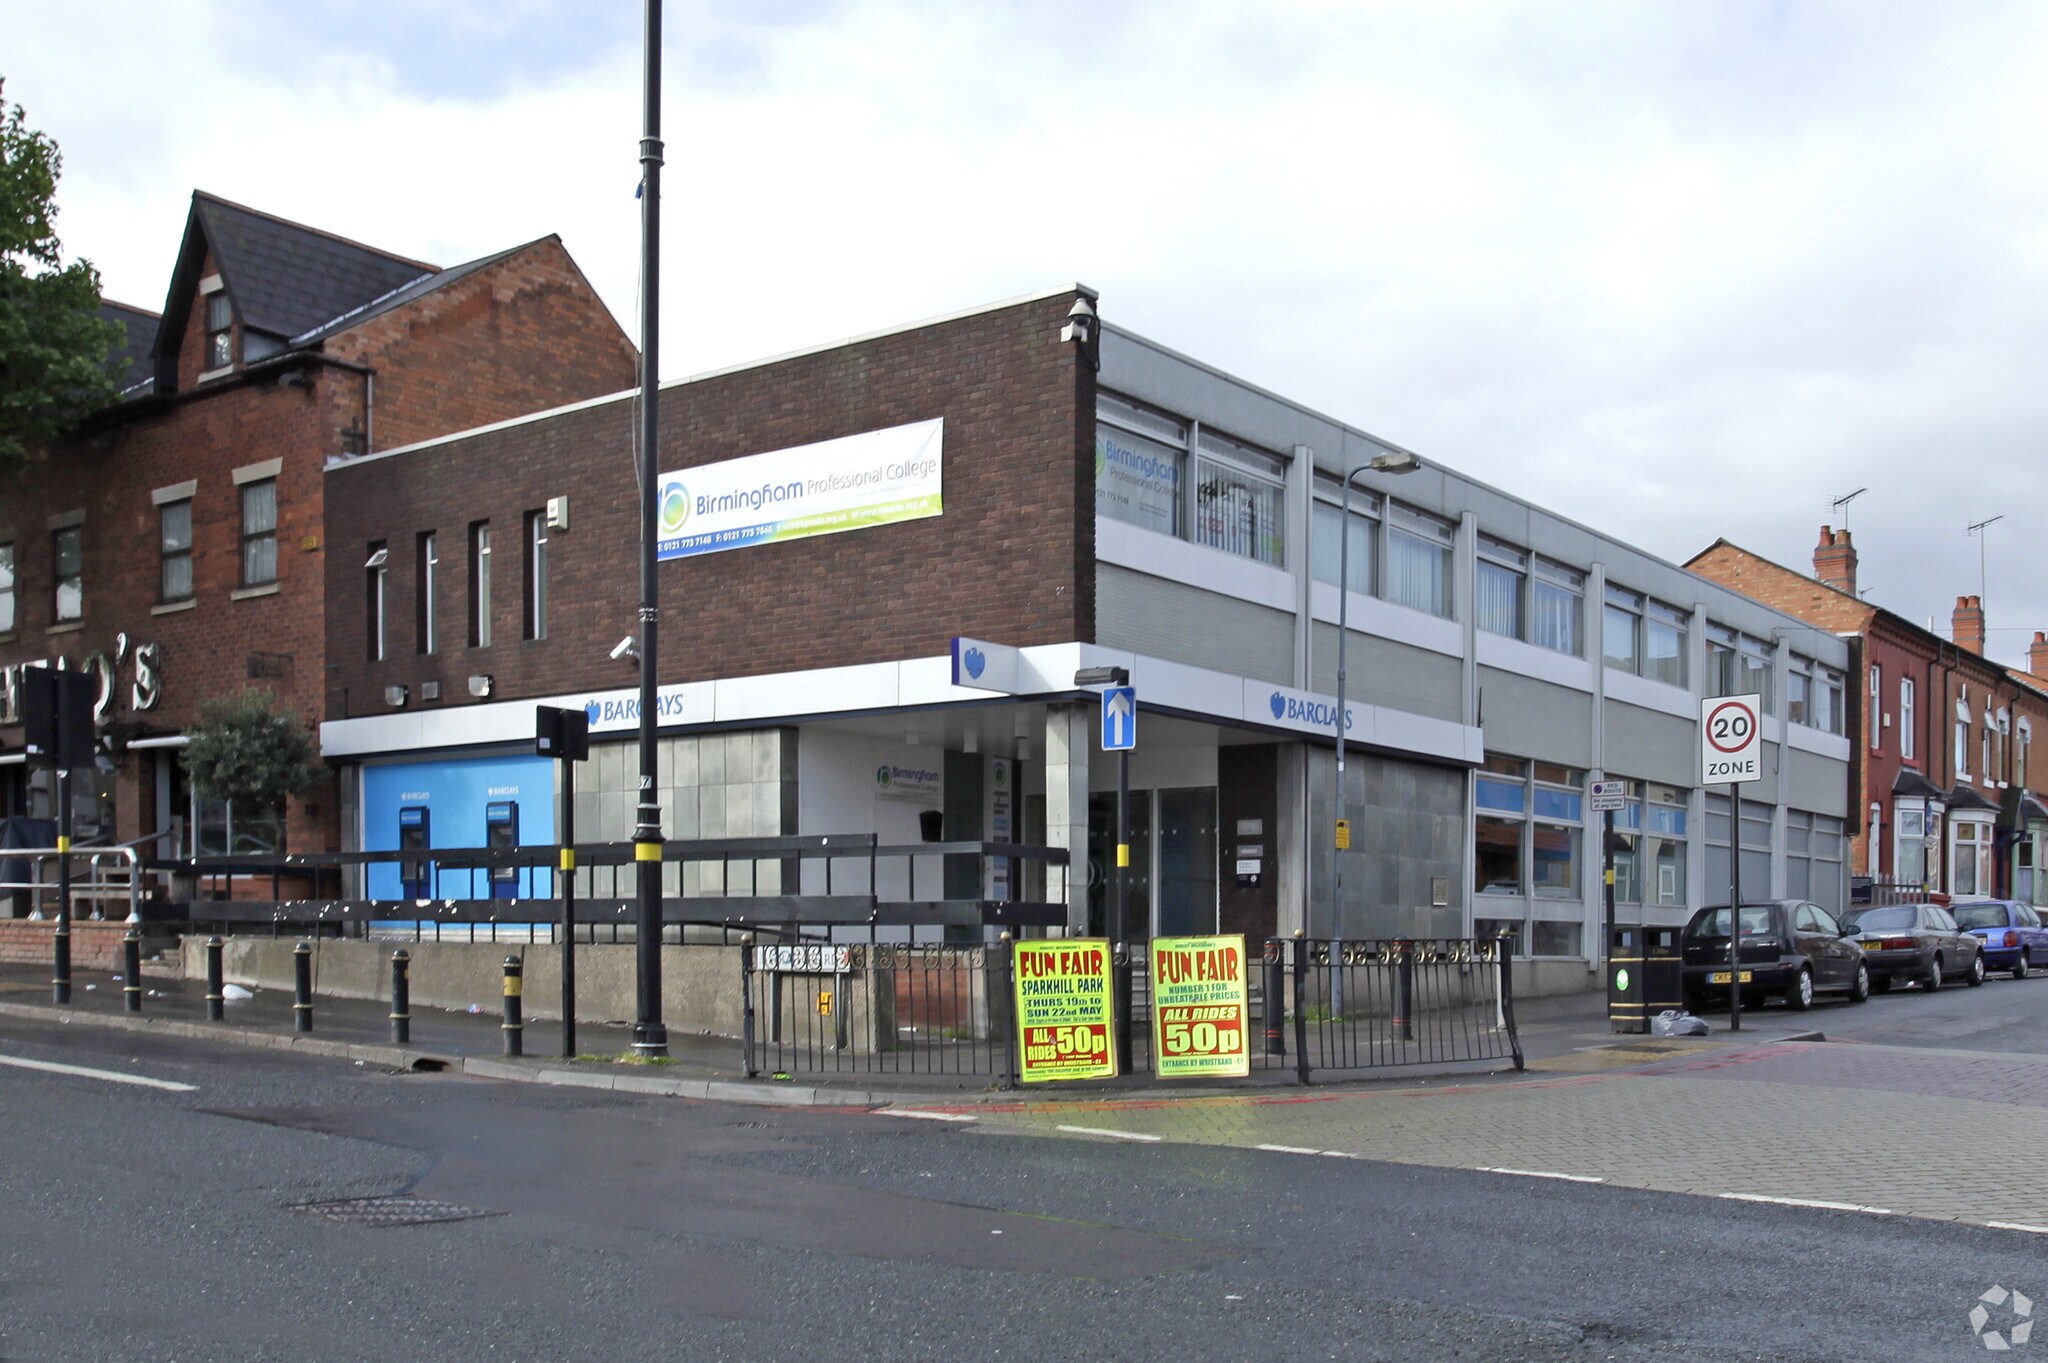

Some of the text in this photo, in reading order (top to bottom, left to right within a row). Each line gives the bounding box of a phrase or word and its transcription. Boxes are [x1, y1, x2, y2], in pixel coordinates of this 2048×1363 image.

[1106, 441, 1178, 483] Birmingham
[696, 481, 803, 516] Birmingham
[807, 465, 883, 495] Professional
[886, 459, 937, 479] College
[1288, 698, 1352, 730] BARCLAS
[1714, 717, 1748, 738] 20
[892, 766, 940, 783] Birmingham
[1709, 761, 1754, 776] ZONE
[1020, 950, 1103, 978] FUN FAIR
[1157, 947, 1238, 985] FUN FAIR
[1022, 978, 1103, 996] SPARKHILL PARK
[1168, 983, 1227, 994] NUMBER 1 FOR
[1027, 998, 1063, 1007] THURS
[1067, 997, 1087, 1006] 19th
[1158, 991, 1240, 1005] UNBEATABLE PRICES
[1027, 1006, 1102, 1018] SUN 22nd MAY
[1164, 1006, 1238, 1021] ALL RIDES
[1033, 1028, 1049, 1044] ALL
[1056, 1026, 1105, 1055] 50p
[1165, 1022, 1240, 1054] 50p
[1027, 1045, 1057, 1061] RIDES
[1162, 1059, 1190, 1068] ENTRANCE
[1190, 1059, 1198, 1067] BY
[1199, 1058, 1232, 1067] WRISTBAND
